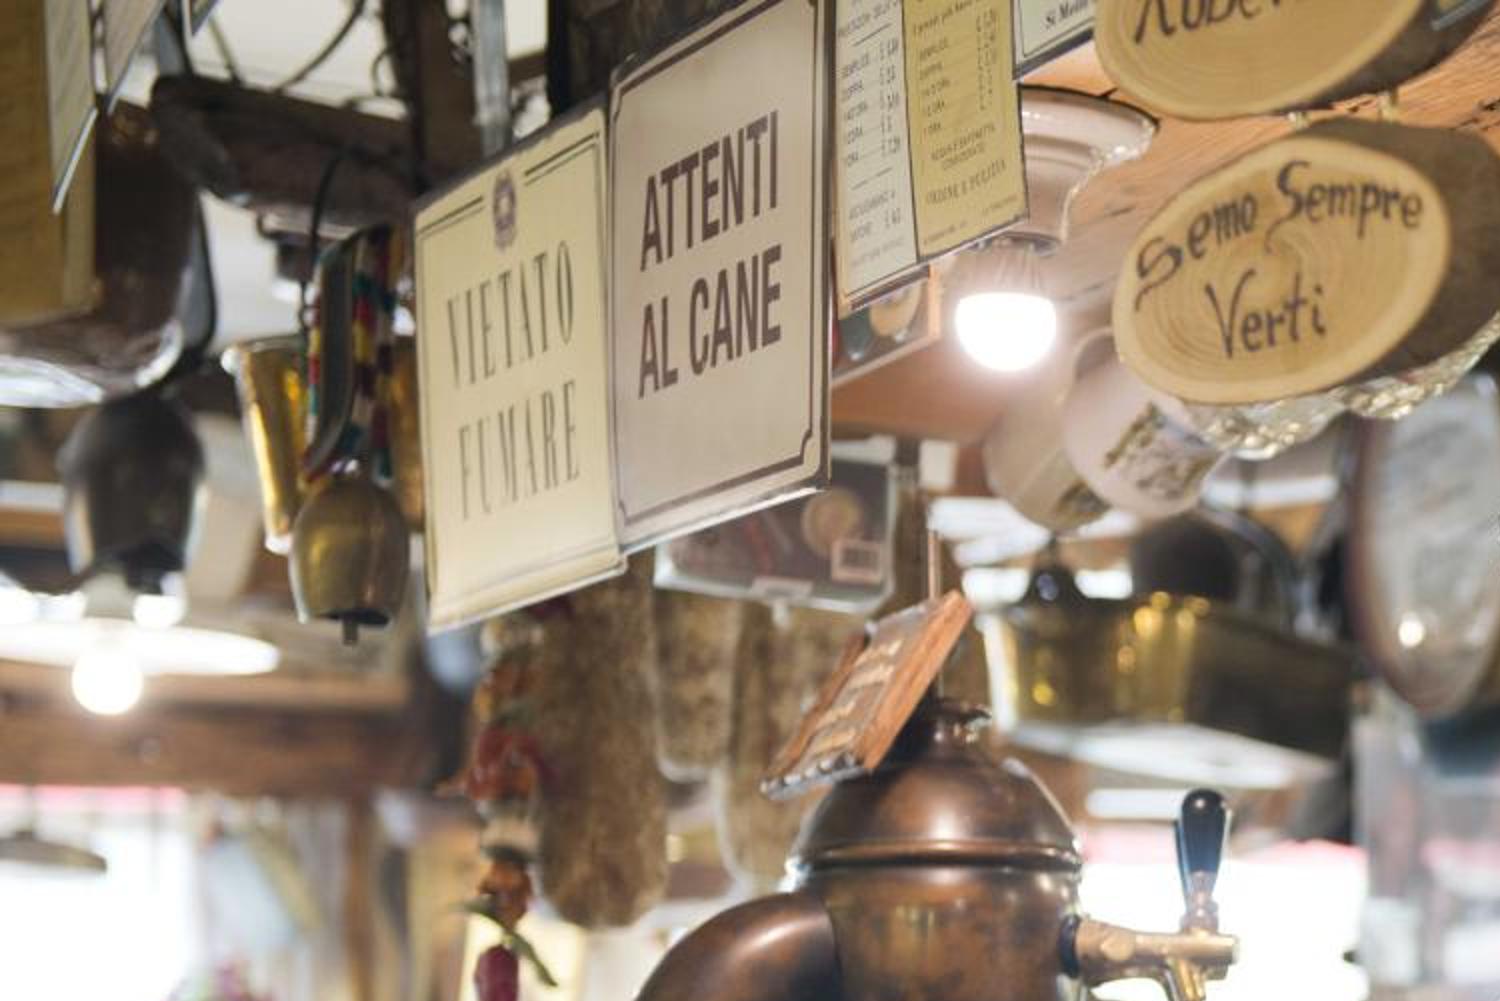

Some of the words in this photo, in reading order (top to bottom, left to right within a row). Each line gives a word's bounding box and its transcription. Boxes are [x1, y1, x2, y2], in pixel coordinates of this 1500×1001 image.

[640, 109, 779, 273] ATTENTI
[1135, 193, 1258, 312] Semo
[1264, 160, 1424, 255] Sempre
[446, 240, 575, 390] VIETATO
[638, 297, 679, 400] AL
[689, 244, 782, 377] CANE
[1204, 268, 1327, 358] Verti
[458, 379, 580, 521] FUMARE
